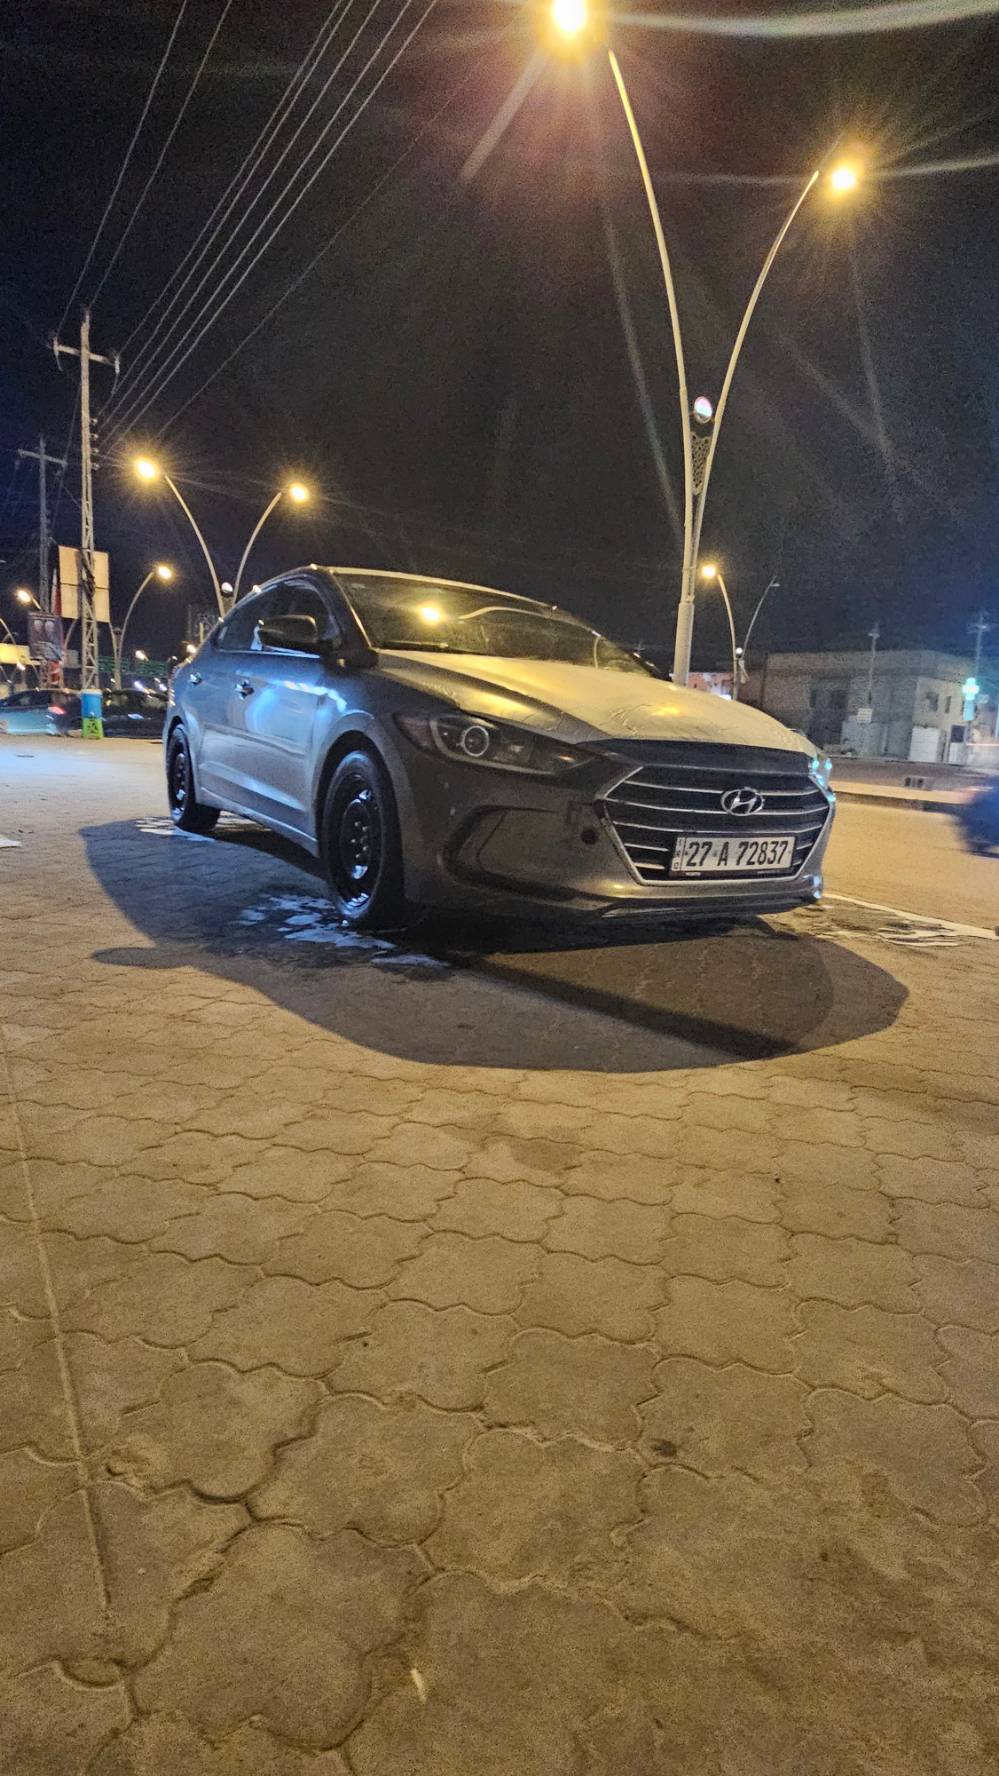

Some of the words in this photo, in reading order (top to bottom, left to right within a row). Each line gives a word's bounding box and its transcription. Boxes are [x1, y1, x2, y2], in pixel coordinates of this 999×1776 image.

[686, 841, 713, 867] 27
[717, 841, 729, 866] A
[736, 840, 788, 866] 72837
